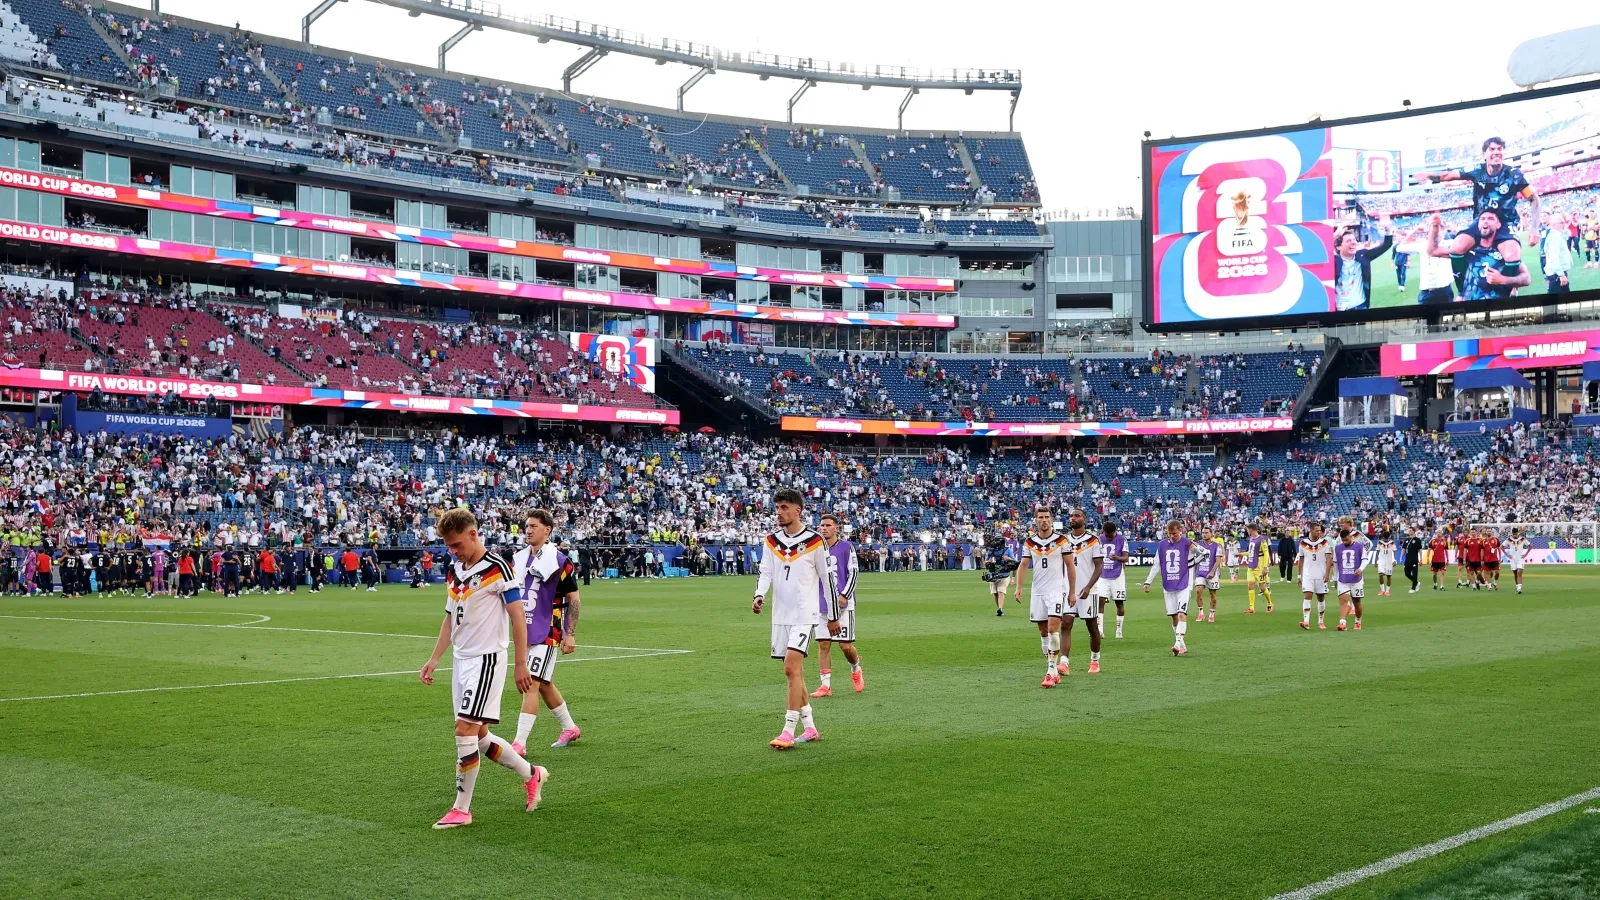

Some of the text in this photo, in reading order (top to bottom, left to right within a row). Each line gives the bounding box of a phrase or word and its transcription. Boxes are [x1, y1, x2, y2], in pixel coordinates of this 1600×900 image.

[42, 176, 69, 191] CUP
[70, 182, 117, 199] 2026
[42, 229, 69, 244] CUP
[70, 234, 117, 249] 2026
[1232, 239, 1253, 248] FIFA
[1217, 255, 1268, 267] WORLD CUP
[1217, 264, 1268, 279] 2026
[1528, 341, 1587, 358] PARAGUAY
[69, 374, 239, 397] FIFA WORLD CUP 2026
[106, 414, 206, 427] FIFA WORLD CUP 2026
[1186, 422, 1210, 432] FIFA
[1210, 420, 1249, 431] WORLD
[1250, 419, 1273, 430] CUP
[1041, 557, 1048, 569] 8
[1312, 554, 1317, 562] 3
[784, 565, 791, 581] 7
[1211, 581, 1219, 589] 22
[1116, 590, 1126, 599] 25
[1055, 603, 1062, 614] 8
[1087, 606, 1092, 616] 4
[455, 606, 464, 626] 6
[798, 632, 808, 648] 7
[461, 689, 473, 710] 6
